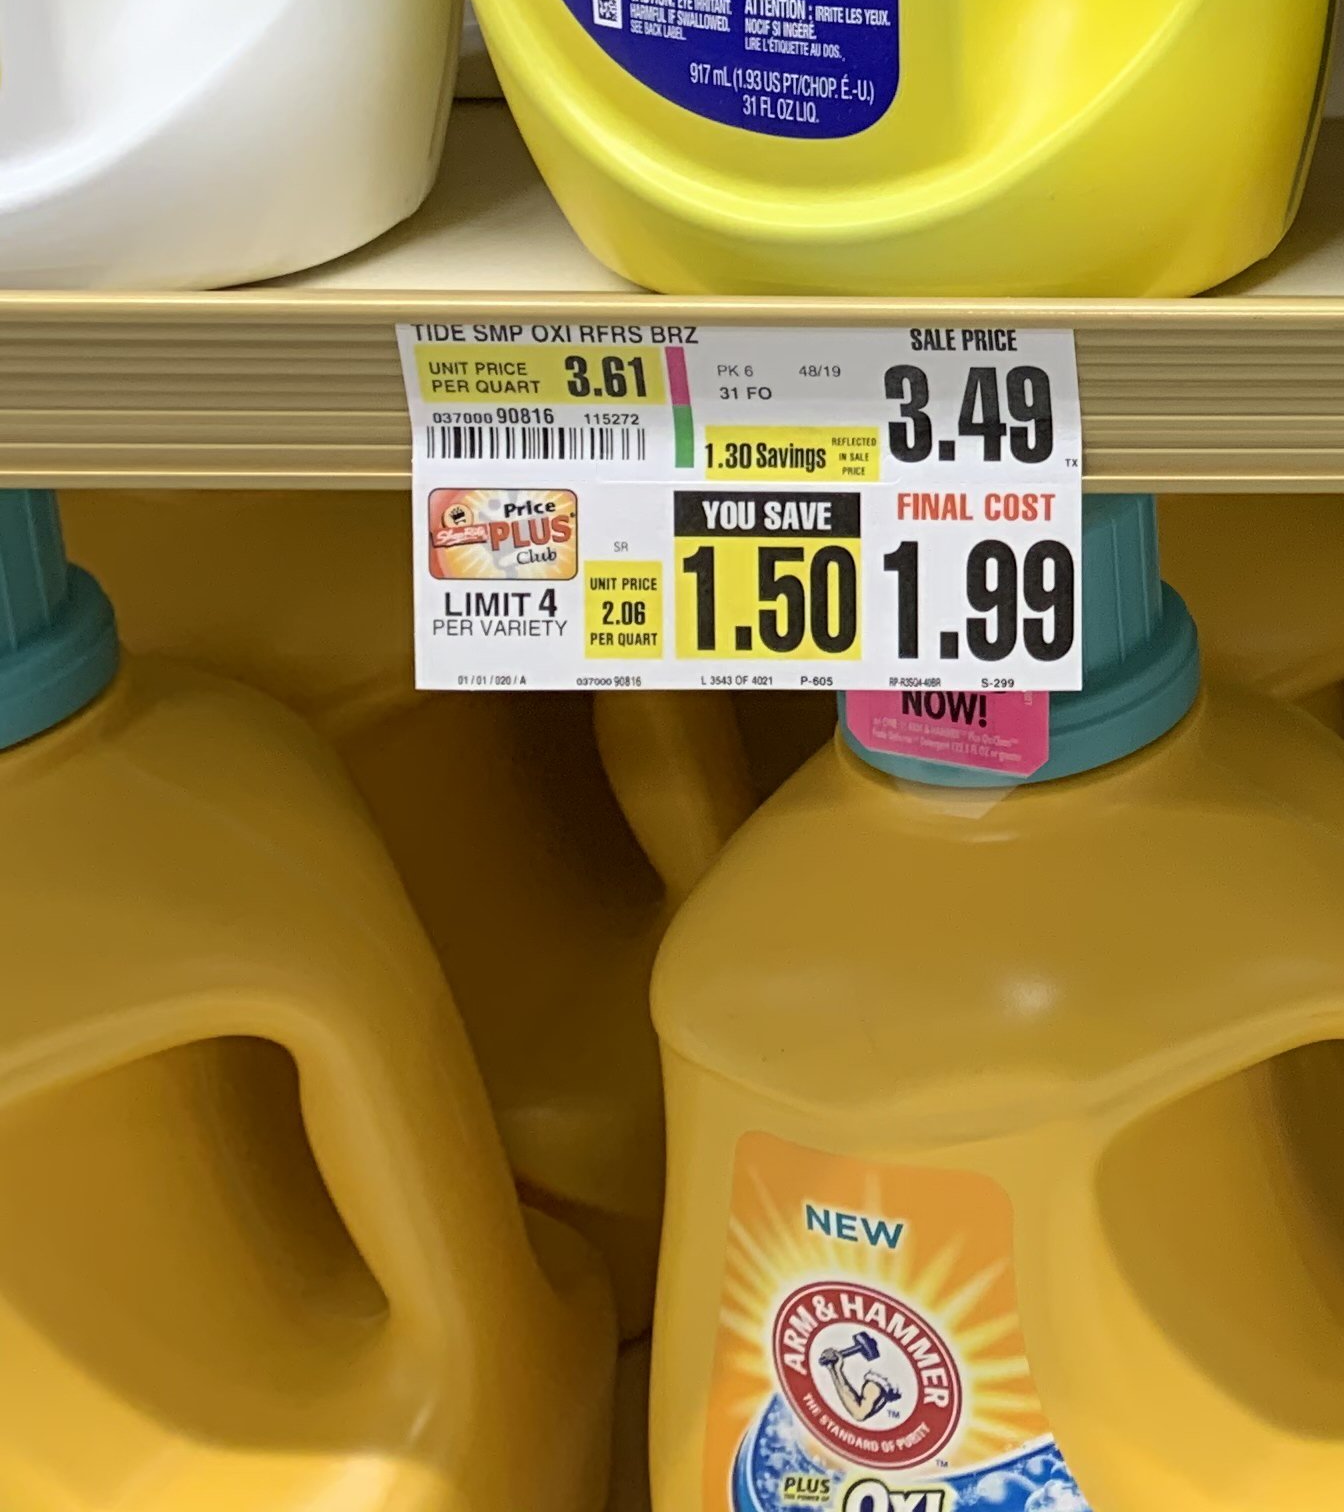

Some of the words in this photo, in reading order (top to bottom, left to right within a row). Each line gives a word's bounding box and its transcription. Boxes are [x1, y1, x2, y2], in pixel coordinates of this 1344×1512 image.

[411, 325, 465, 341] TIDE
[474, 325, 523, 342] SMP
[531, 326, 571, 342] OXI
[580, 326, 643, 344] RFRS
[651, 327, 699, 344] BRZ
[911, 329, 956, 351] SALE
[963, 329, 1017, 351] PRICE
[428, 362, 469, 375] UNIT
[475, 363, 527, 376] PRICE
[564, 355, 647, 398] 3.61
[717, 365, 740, 377] PK
[744, 366, 754, 377] 6
[799, 366, 841, 378] 48/19
[432, 380, 469, 393] PER
[476, 381, 540, 394] QUART
[720, 388, 738, 400] 31
[746, 387, 772, 400] FO
[433, 413, 492, 424] 037000
[496, 408, 554, 424] 90816
[584, 414, 639, 425] 115272
[884, 364, 1054, 464] 3.49
[705, 443, 750, 469] 1.30
[756, 443, 826, 473] Savings
[504, 501, 556, 518] Price
[702, 501, 755, 530] YOU
[764, 501, 832, 530] SAVE
[897, 493, 973, 520] FINAL
[984, 493, 1055, 521] COST
[489, 515, 573, 551] PLUS
[516, 550, 557, 565] Club
[590, 578, 617, 591] UNIT
[622, 578, 657, 591] PRICE
[445, 592, 531, 617] LIMIT
[538, 588, 557, 617] 4
[683, 545, 857, 654] 1.50
[883, 539, 1075, 661] 1.99
[602, 601, 645, 625] 2.06
[433, 620, 473, 636] PER
[481, 620, 568, 636] VARIETY
[590, 633, 614, 646] PER
[618, 633, 657, 646] QUART
[801, 676, 833, 686] P-605
[981, 678, 1014, 688] S-299
[902, 691, 987, 728] NOW!
[805, 1203, 904, 1249] NEW
[783, 1305, 819, 1374] ARM
[812, 1295, 838, 1322] &
[840, 1292, 950, 1409] HAMMER
[784, 1477, 830, 1493] PLUS
